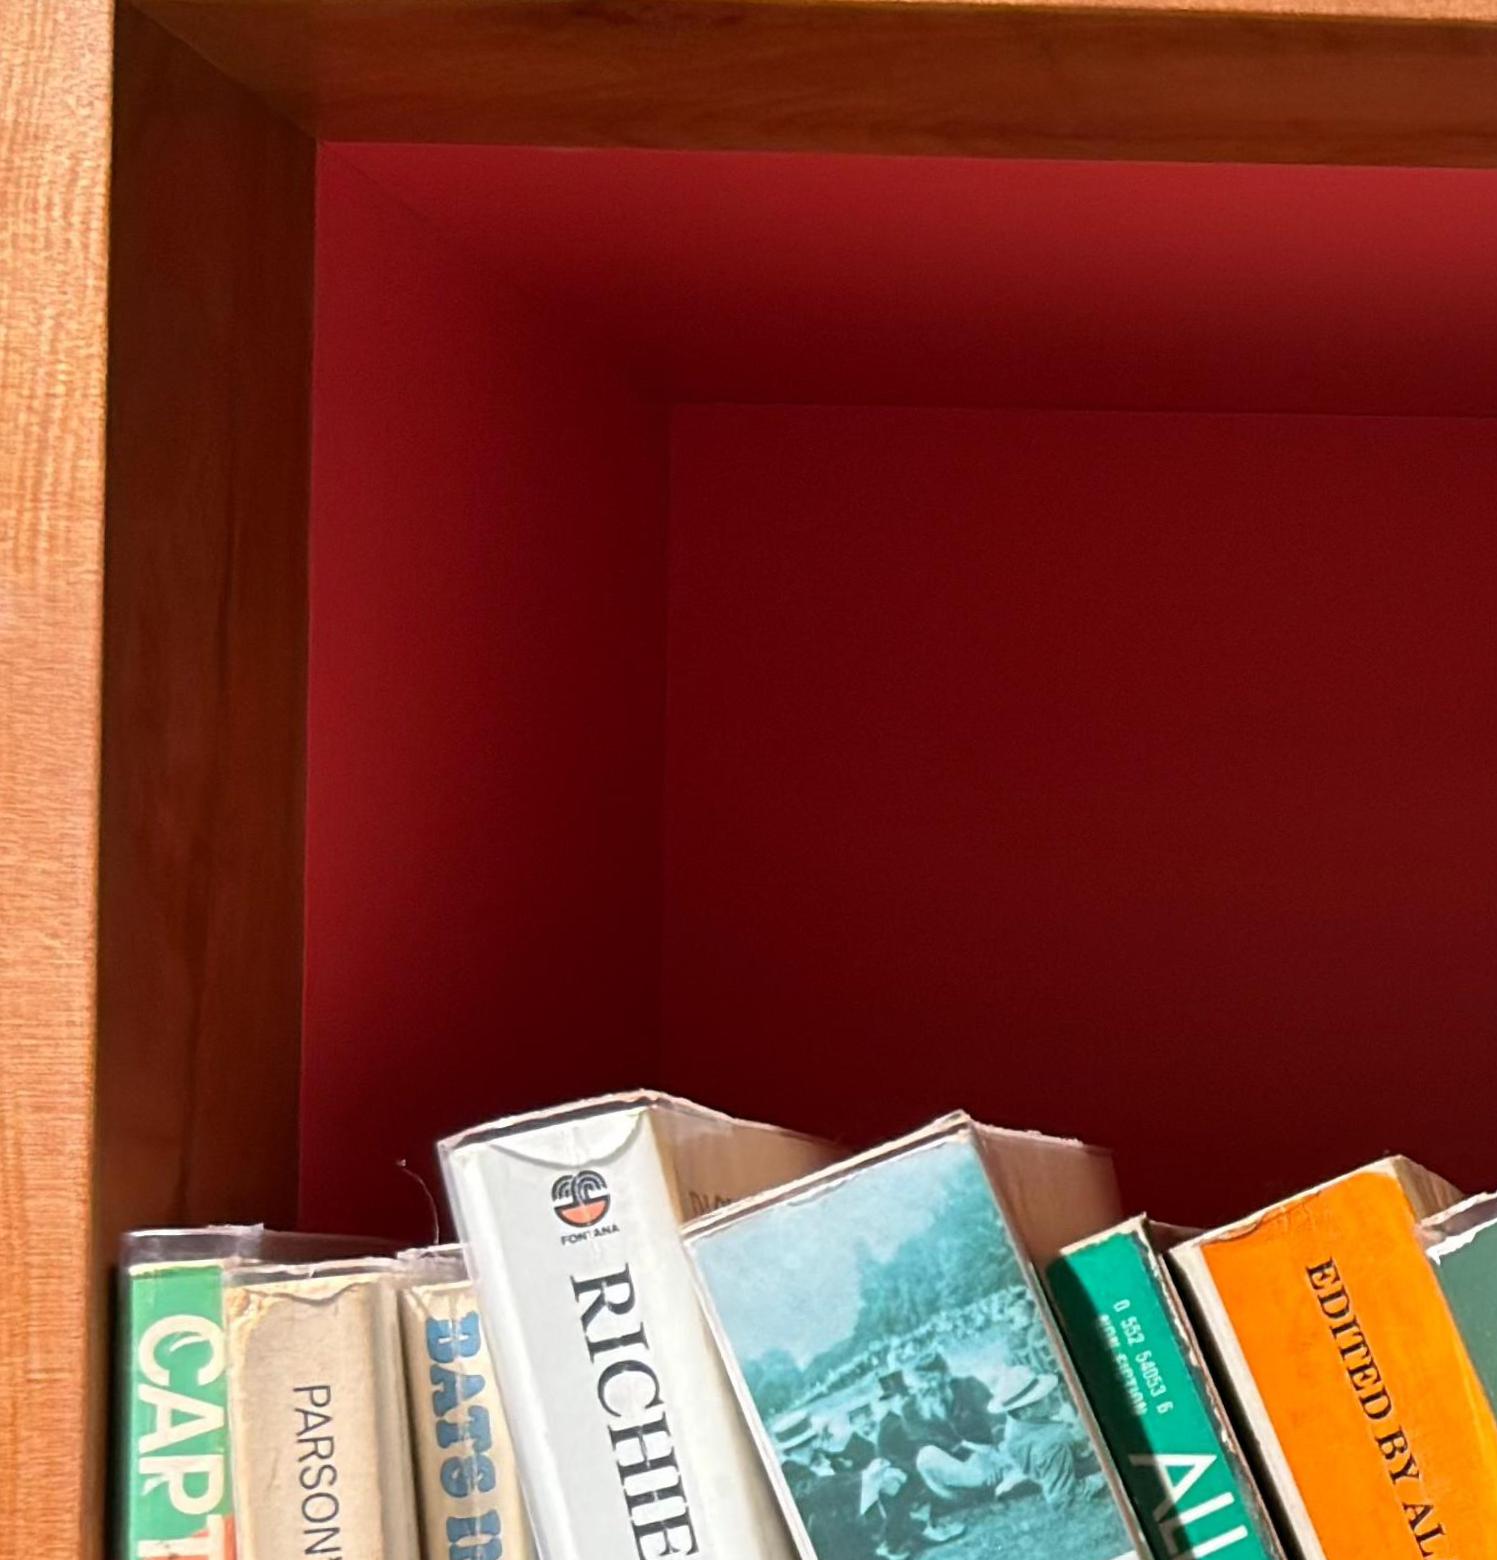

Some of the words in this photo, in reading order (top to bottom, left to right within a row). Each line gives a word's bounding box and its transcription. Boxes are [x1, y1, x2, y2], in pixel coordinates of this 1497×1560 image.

[425, 1311, 497, 1499] BATS
[1120, 1316, 1143, 1345] 552
[1157, 1402, 1172, 1414] 6
[1305, 1257, 1394, 1424] EDITED
[1378, 1427, 1421, 1488] BY
